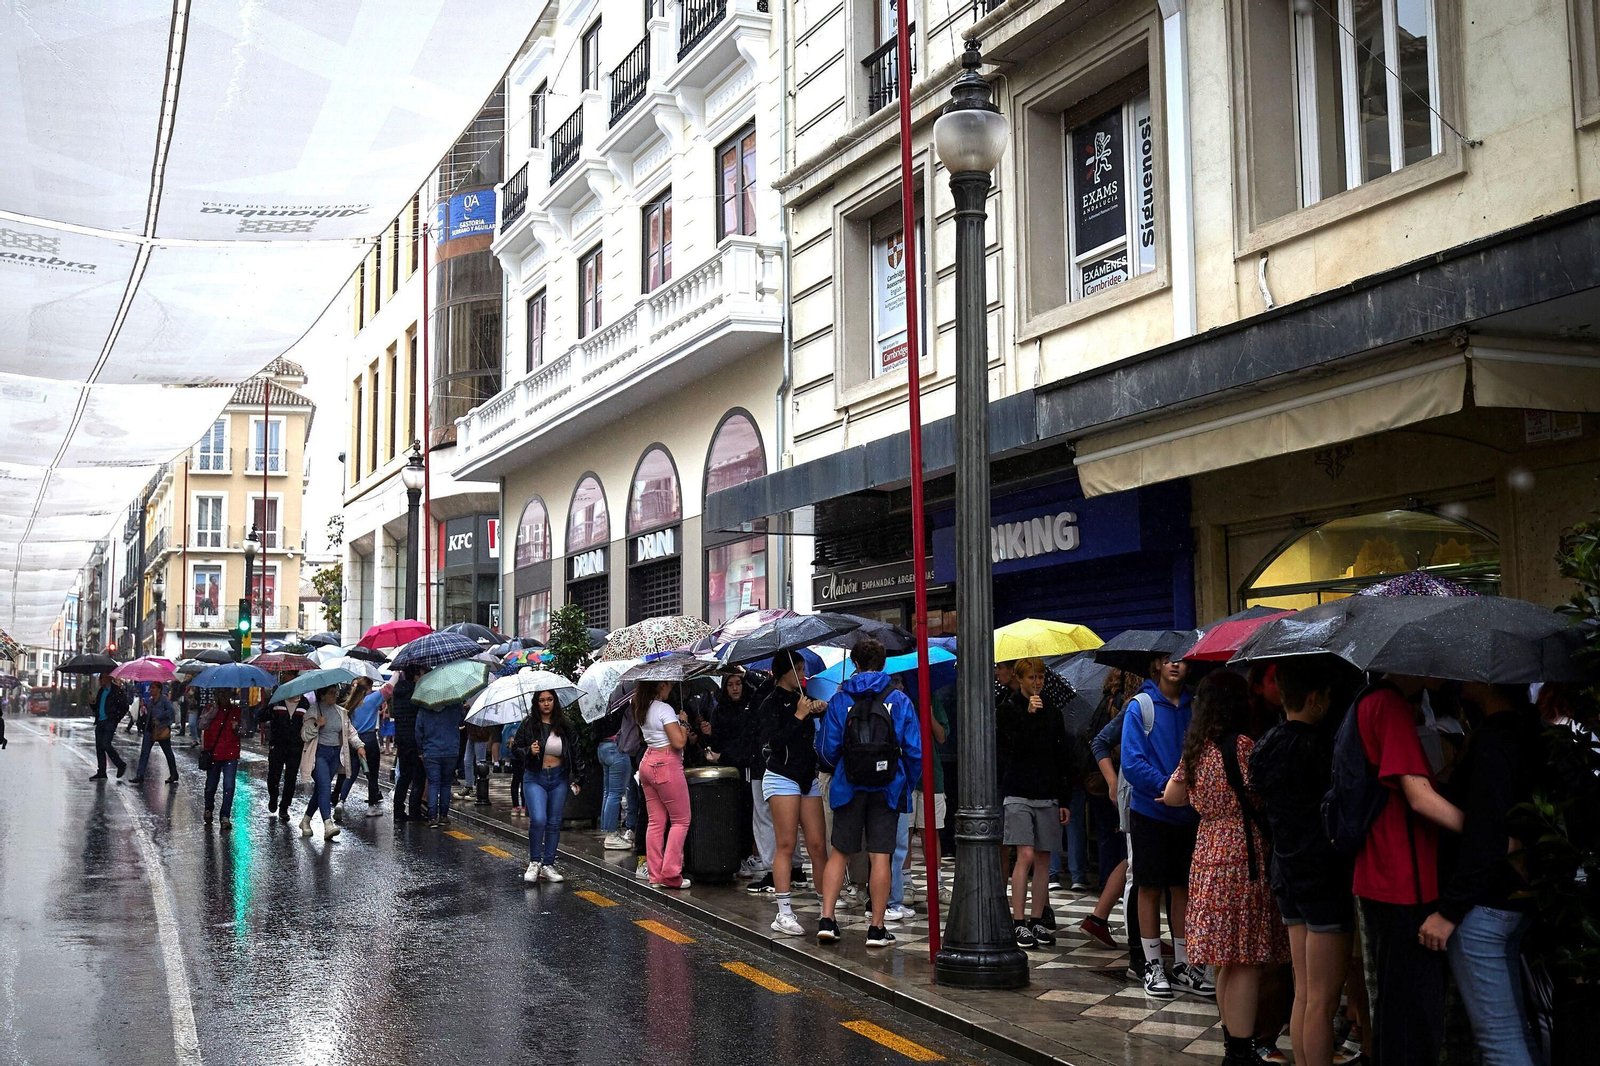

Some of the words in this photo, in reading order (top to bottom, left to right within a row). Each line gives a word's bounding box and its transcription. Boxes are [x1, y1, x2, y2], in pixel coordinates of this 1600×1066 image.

[1082, 180, 1118, 209] EXAMS
[1082, 194, 1119, 216] ANDALUCIA
[199, 207, 374, 218] Alhambra
[1083, 256, 1127, 283] EXÁMENES
[1085, 274, 1122, 296] Cambridge
[883, 346, 908, 363] Cambridge
[447, 532, 473, 552] KFC
[637, 528, 675, 562] DRUNI
[573, 548, 604, 579] DRUNI
[821, 571, 858, 600] Malvón
[861, 576, 895, 590] EMPANADAS
